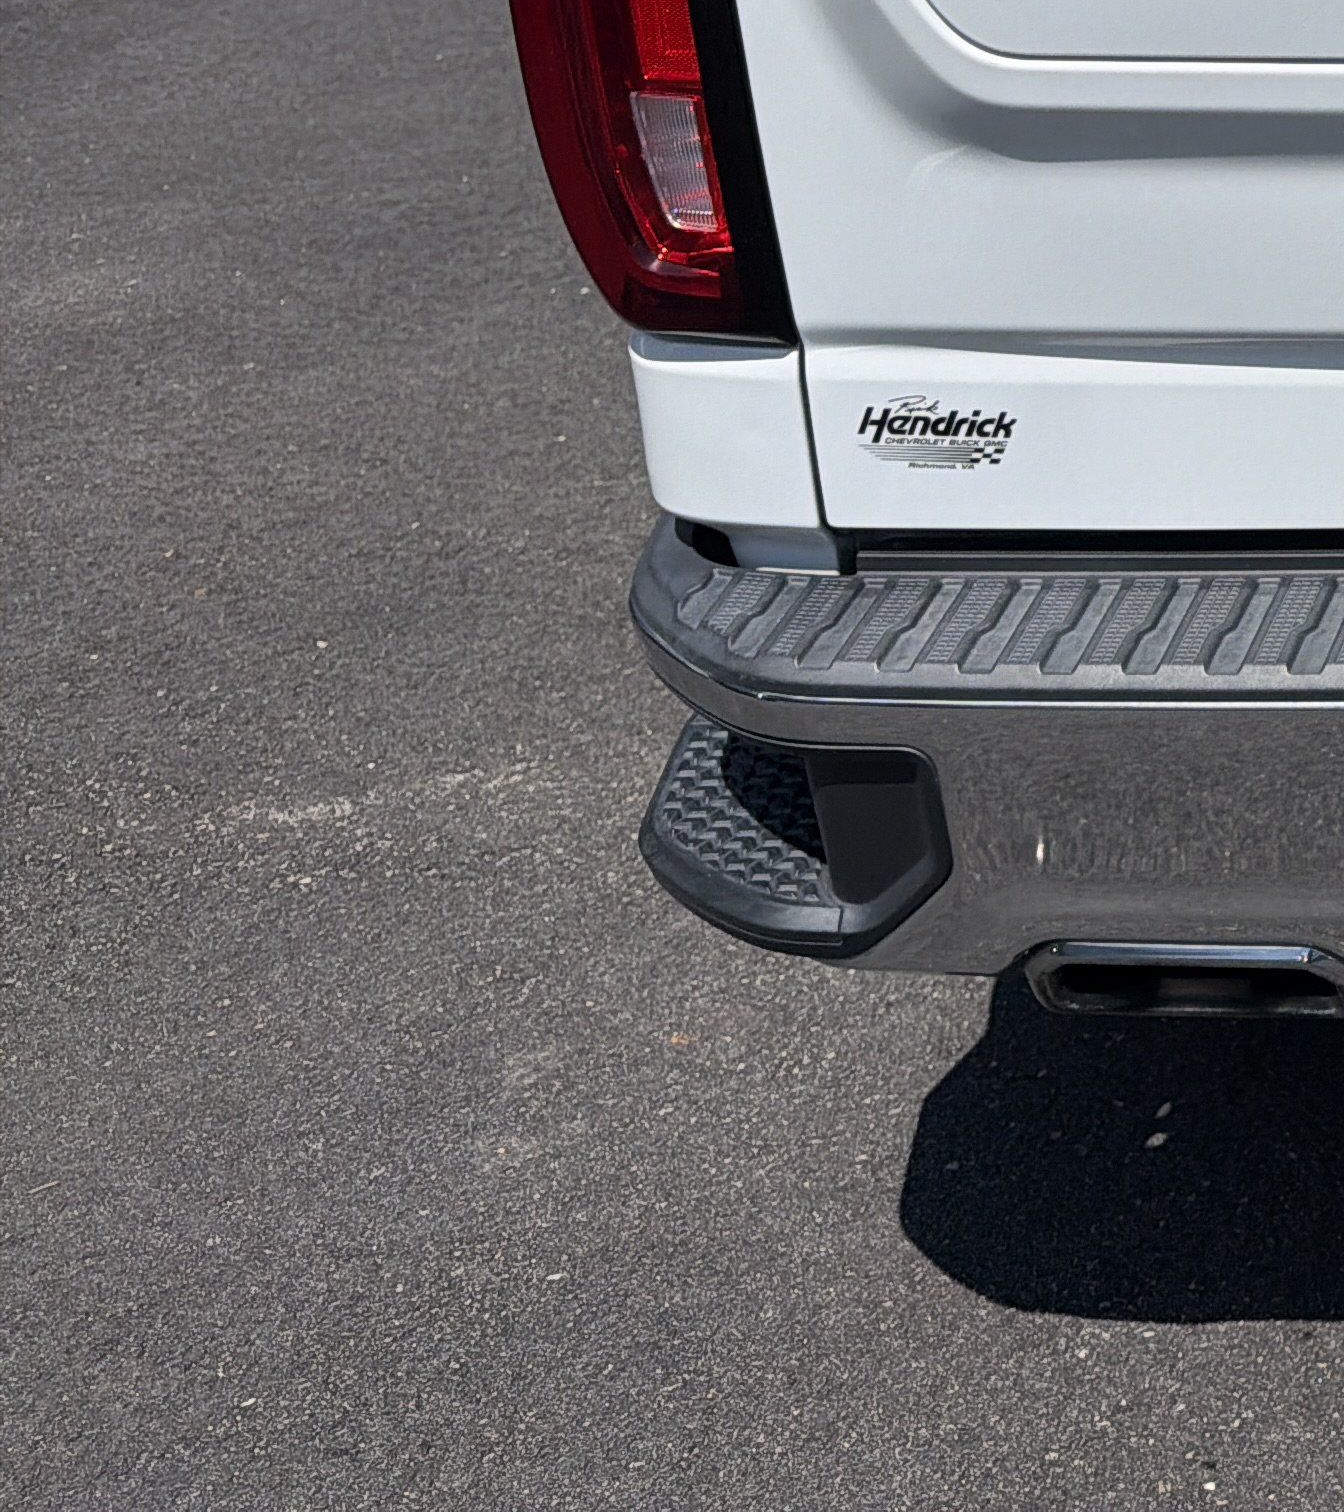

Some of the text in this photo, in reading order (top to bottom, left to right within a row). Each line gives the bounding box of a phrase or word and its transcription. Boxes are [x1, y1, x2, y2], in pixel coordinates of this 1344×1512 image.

[857, 406, 1018, 443] Hendrick
[885, 437, 946, 446] CHEVROLET
[949, 439, 980, 447] BUICK
